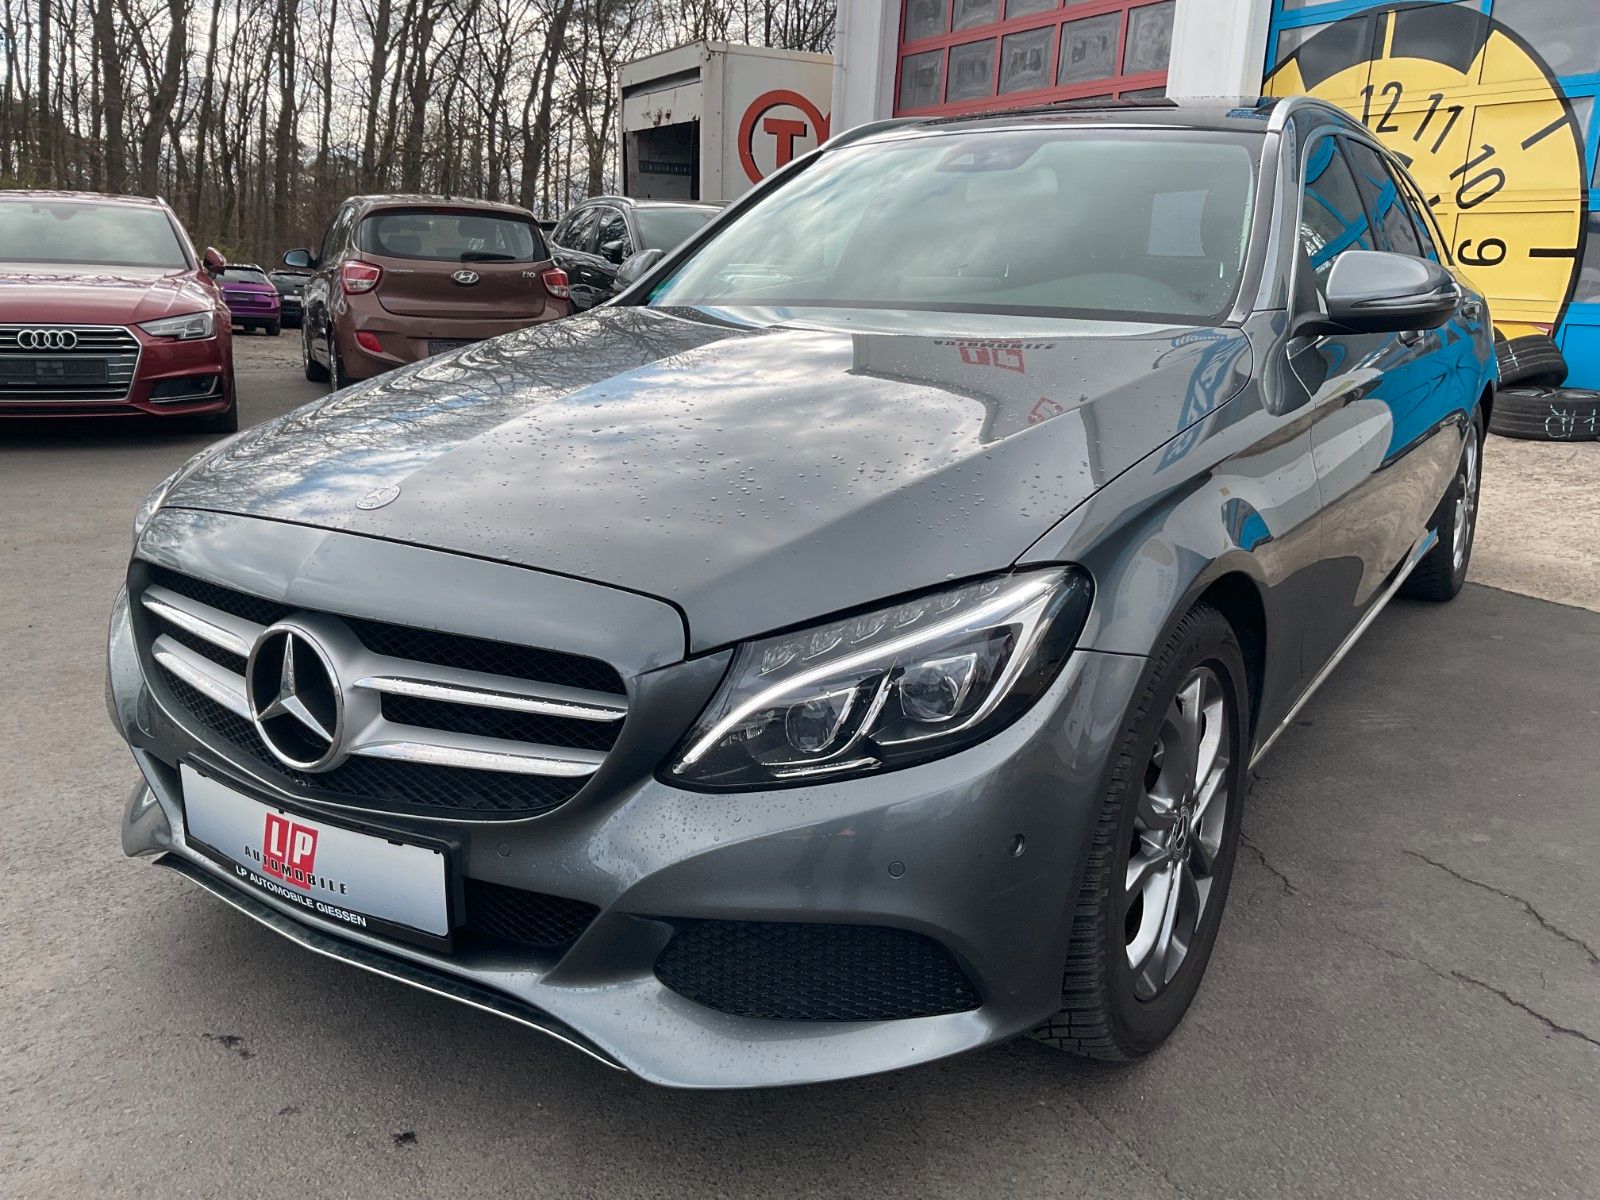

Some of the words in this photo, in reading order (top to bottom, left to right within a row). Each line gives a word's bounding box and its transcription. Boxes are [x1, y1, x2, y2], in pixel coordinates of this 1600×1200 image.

[1360, 81, 1403, 133] 12
[1412, 93, 1464, 154] 11
[1449, 144, 1506, 209] 10
[269, 819, 315, 865] LP
[235, 864, 248, 877] LP
[250, 872, 314, 908] AUTOMOBILE
[316, 902, 367, 927] GIESSEN
[244, 845, 348, 896] AUTOMOBILE
